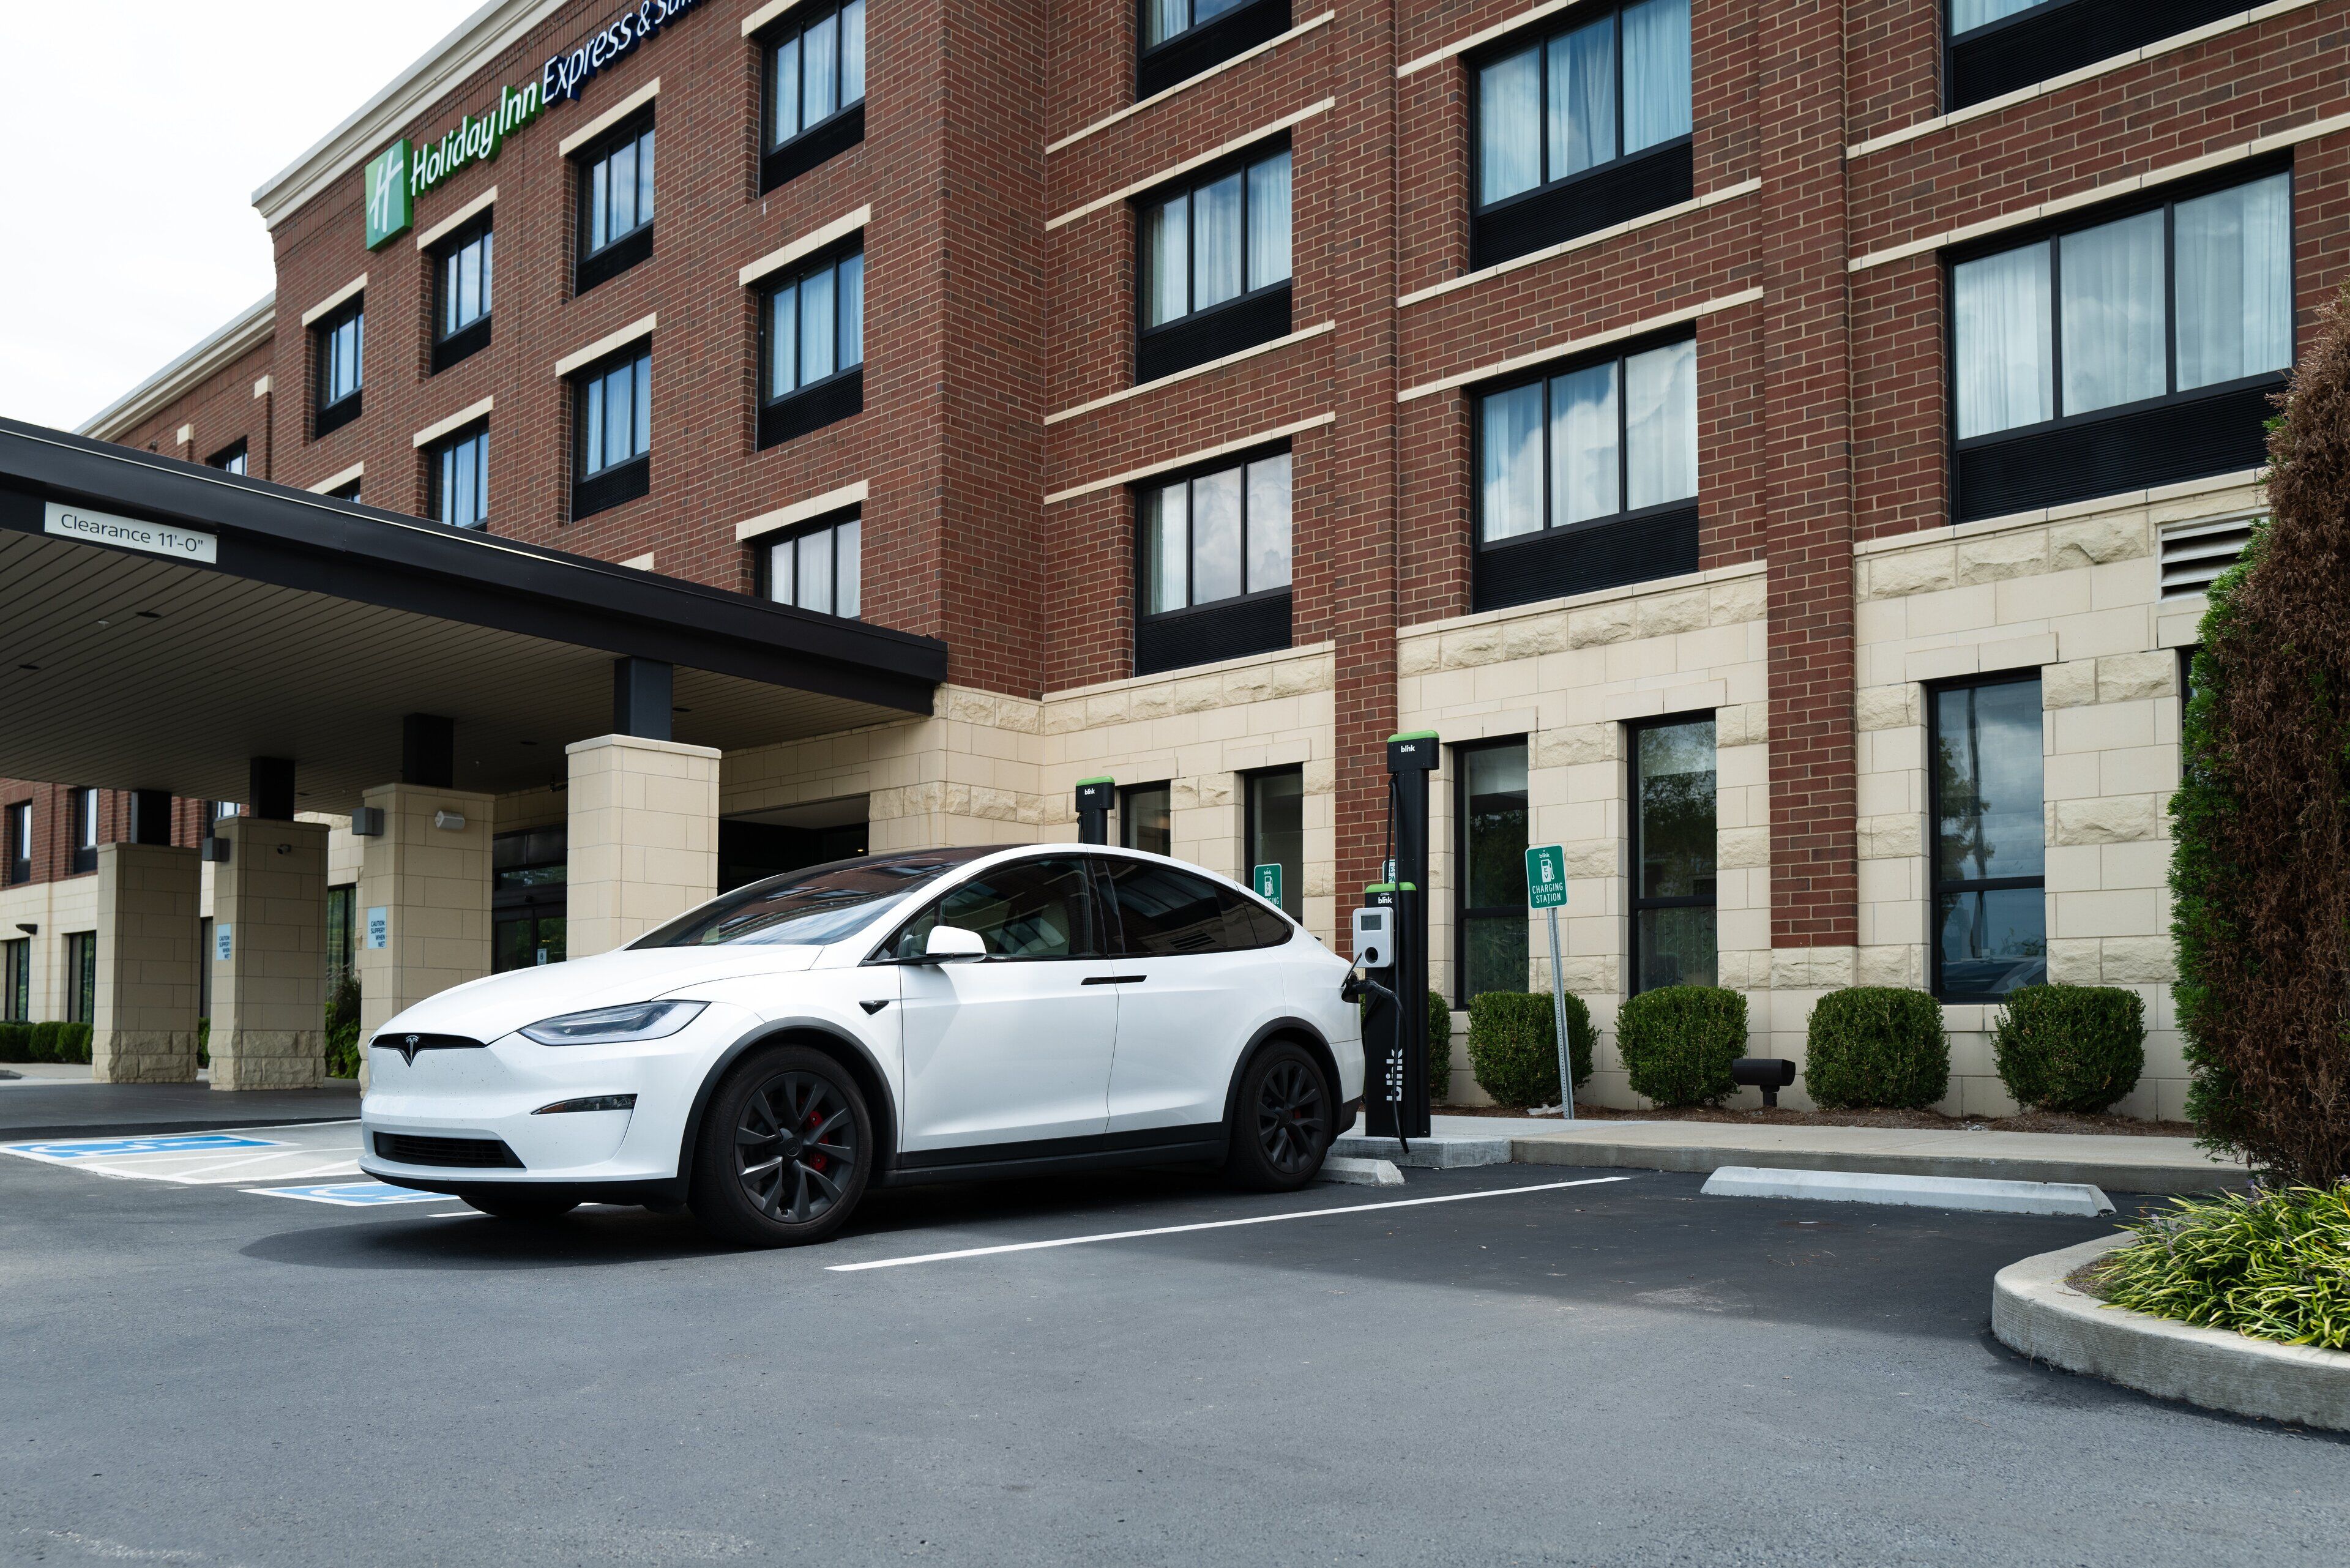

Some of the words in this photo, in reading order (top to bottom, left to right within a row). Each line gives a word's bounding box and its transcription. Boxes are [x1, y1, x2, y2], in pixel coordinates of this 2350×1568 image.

[410, 111, 496, 196] Holiday
[499, 81, 537, 135] Inn
[542, 12, 633, 105] Express
[637, 0, 651, 36] &
[61, 514, 151, 543] Clearance
[159, 532, 203, 551] 11'-0"
[1400, 744, 1416, 753] blink
[1532, 882, 1564, 894] CHARGING
[1535, 892, 1561, 903] STATION
[1386, 1048, 1403, 1101] blink
